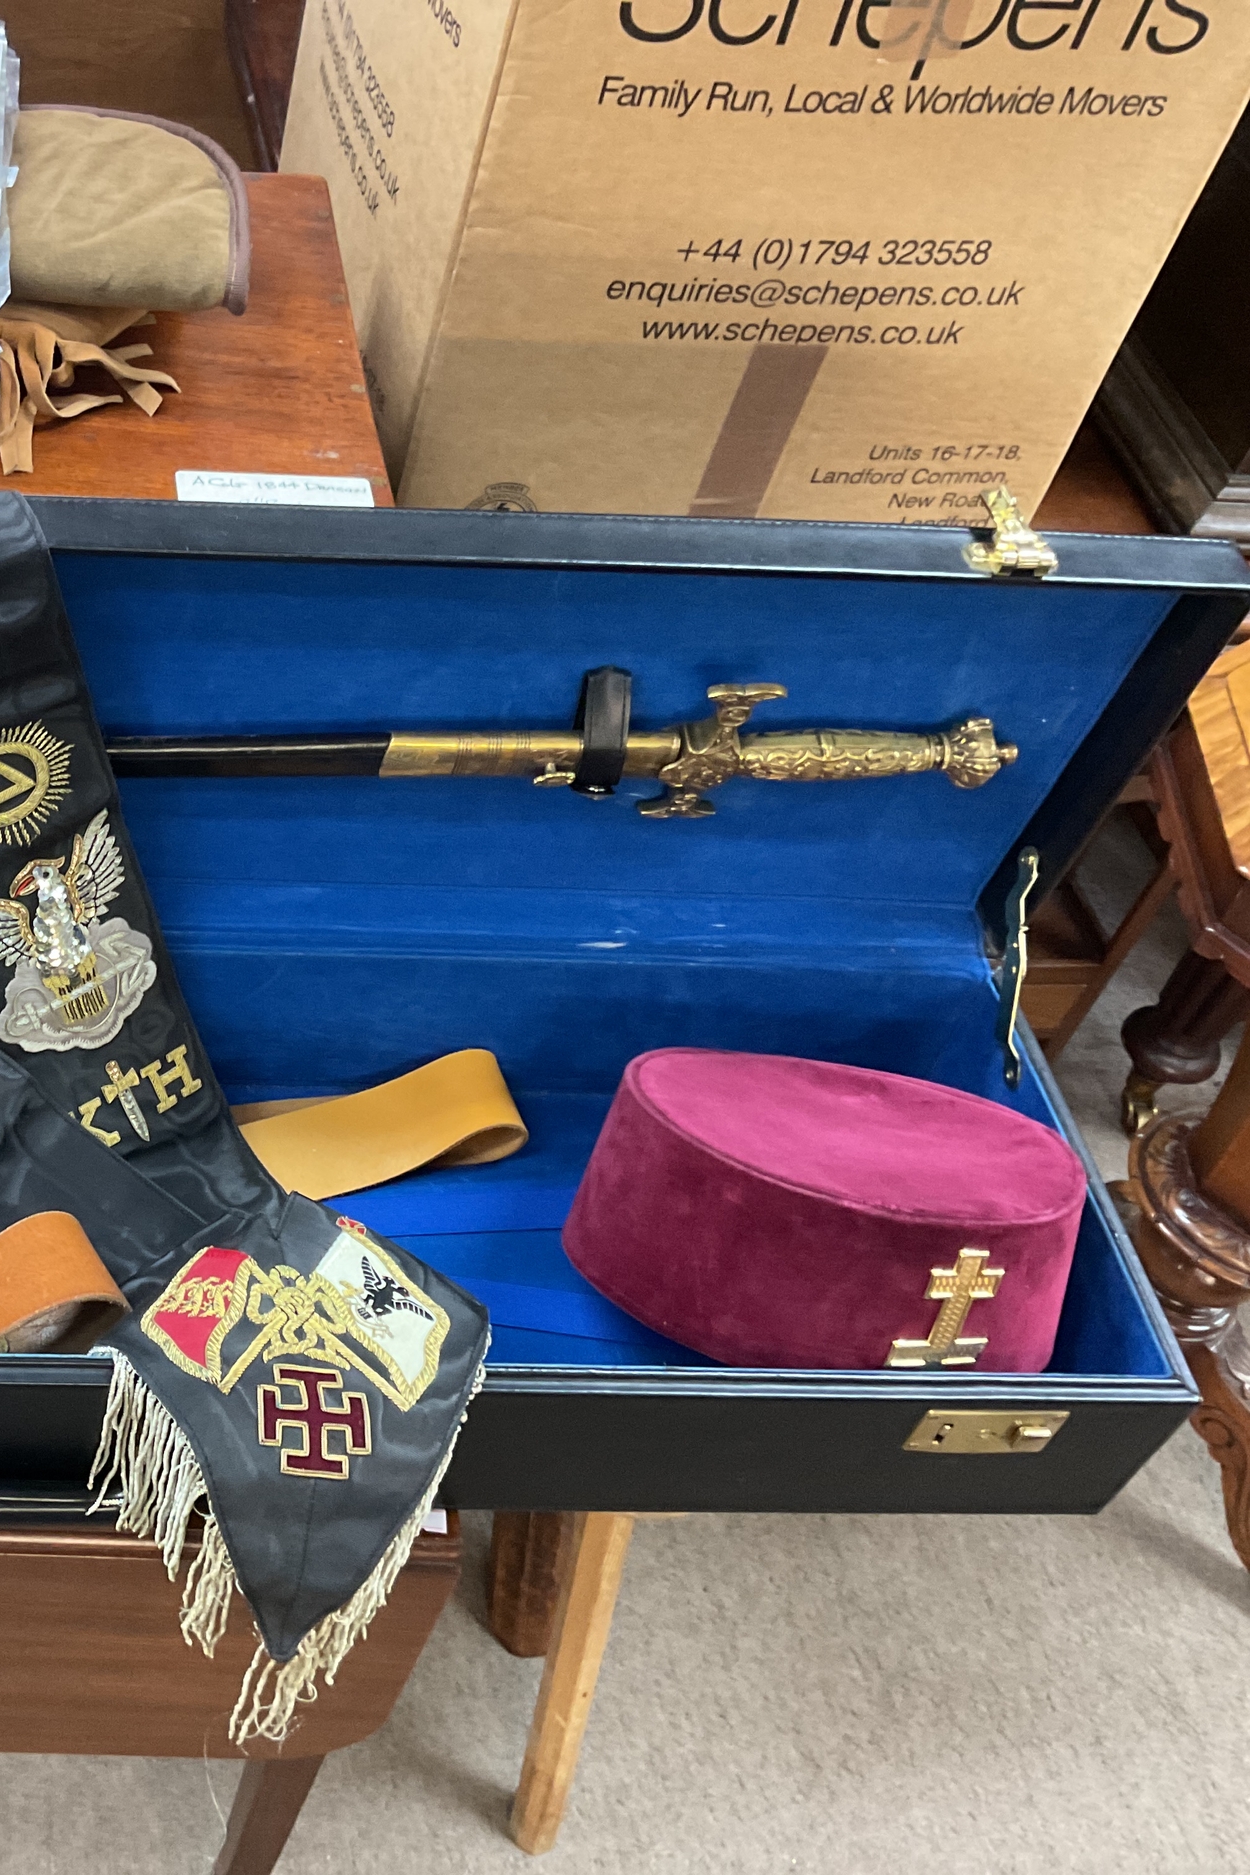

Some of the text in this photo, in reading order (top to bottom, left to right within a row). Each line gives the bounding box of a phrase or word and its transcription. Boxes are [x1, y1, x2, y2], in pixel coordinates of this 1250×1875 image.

[598, 76, 1168, 117] Family Run, Local & Worldwide Movers
[677, 238, 993, 271] +44 (0)1794 323558
[606, 278, 1026, 311] enquiries@schepens.co.uk
[641, 318, 965, 345] www.schepens.co.uk
[868, 444, 922, 461] Units
[810, 467, 908, 484] Landford
[887, 492, 936, 508] New
